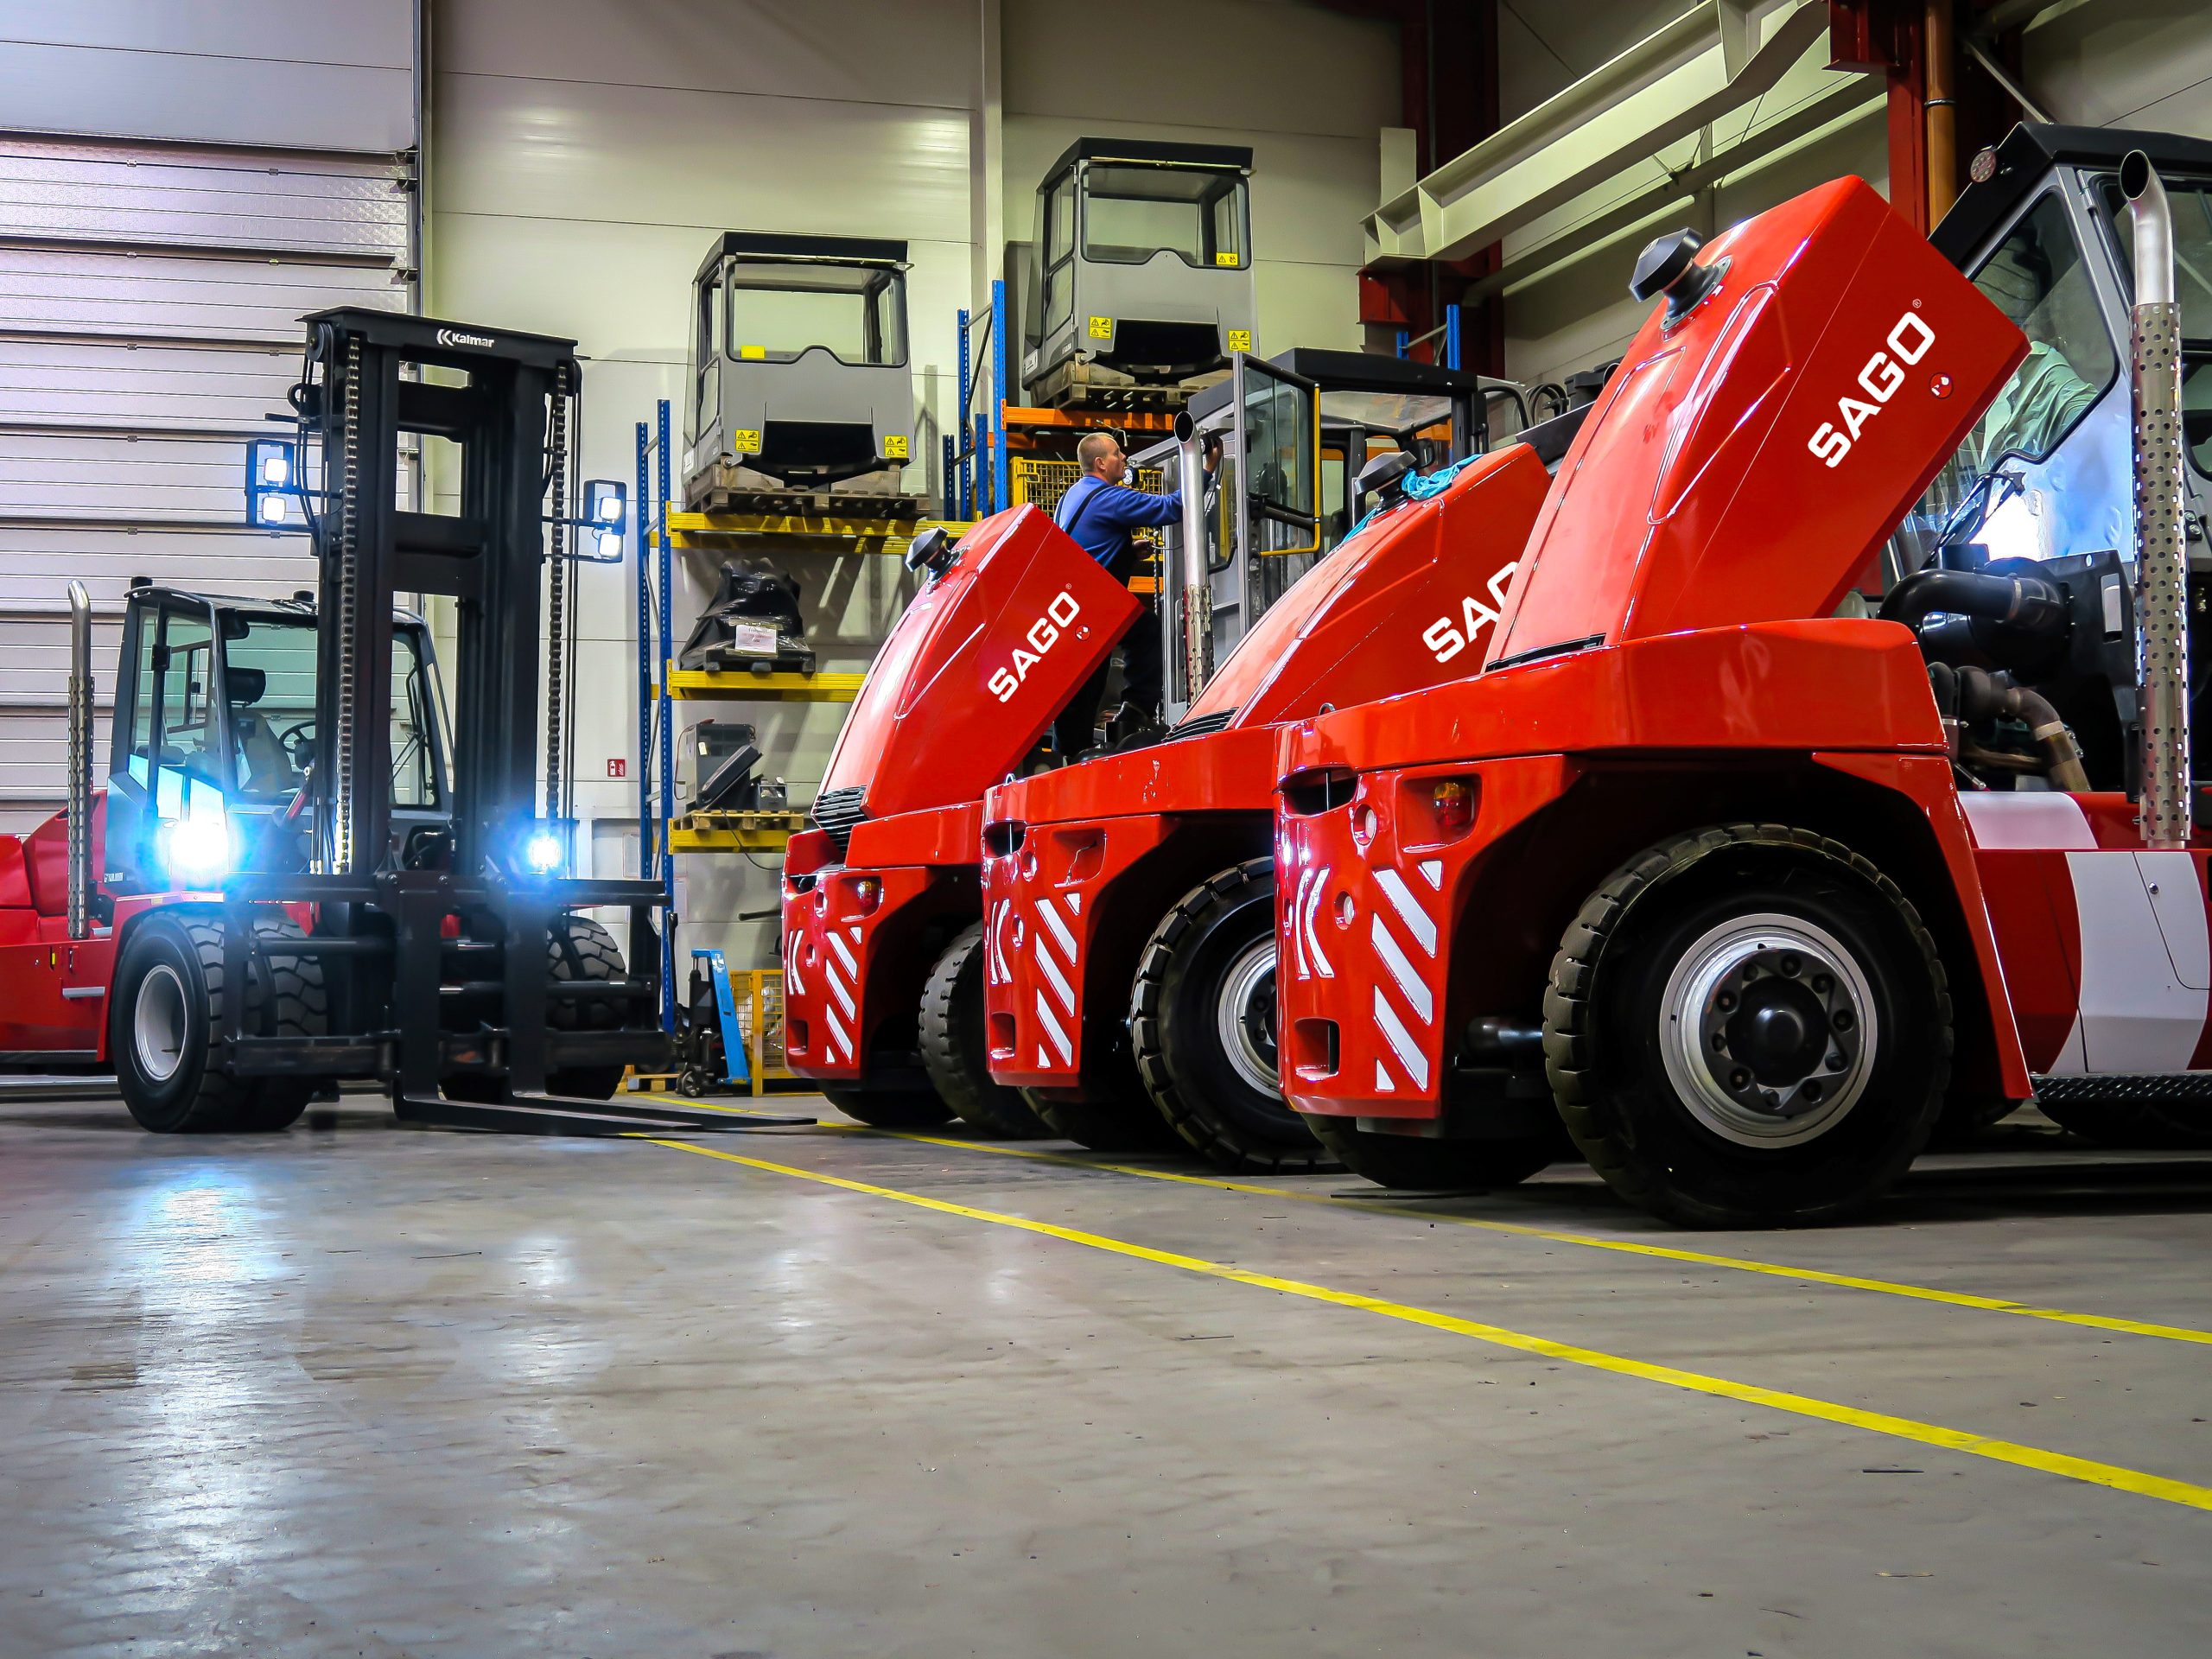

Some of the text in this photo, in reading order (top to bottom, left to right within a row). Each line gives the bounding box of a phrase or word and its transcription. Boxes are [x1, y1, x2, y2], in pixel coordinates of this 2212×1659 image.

[452, 333, 495, 347] Kalmar
[1808, 312, 1936, 468] SAGO
[988, 591, 1080, 703] SAGO
